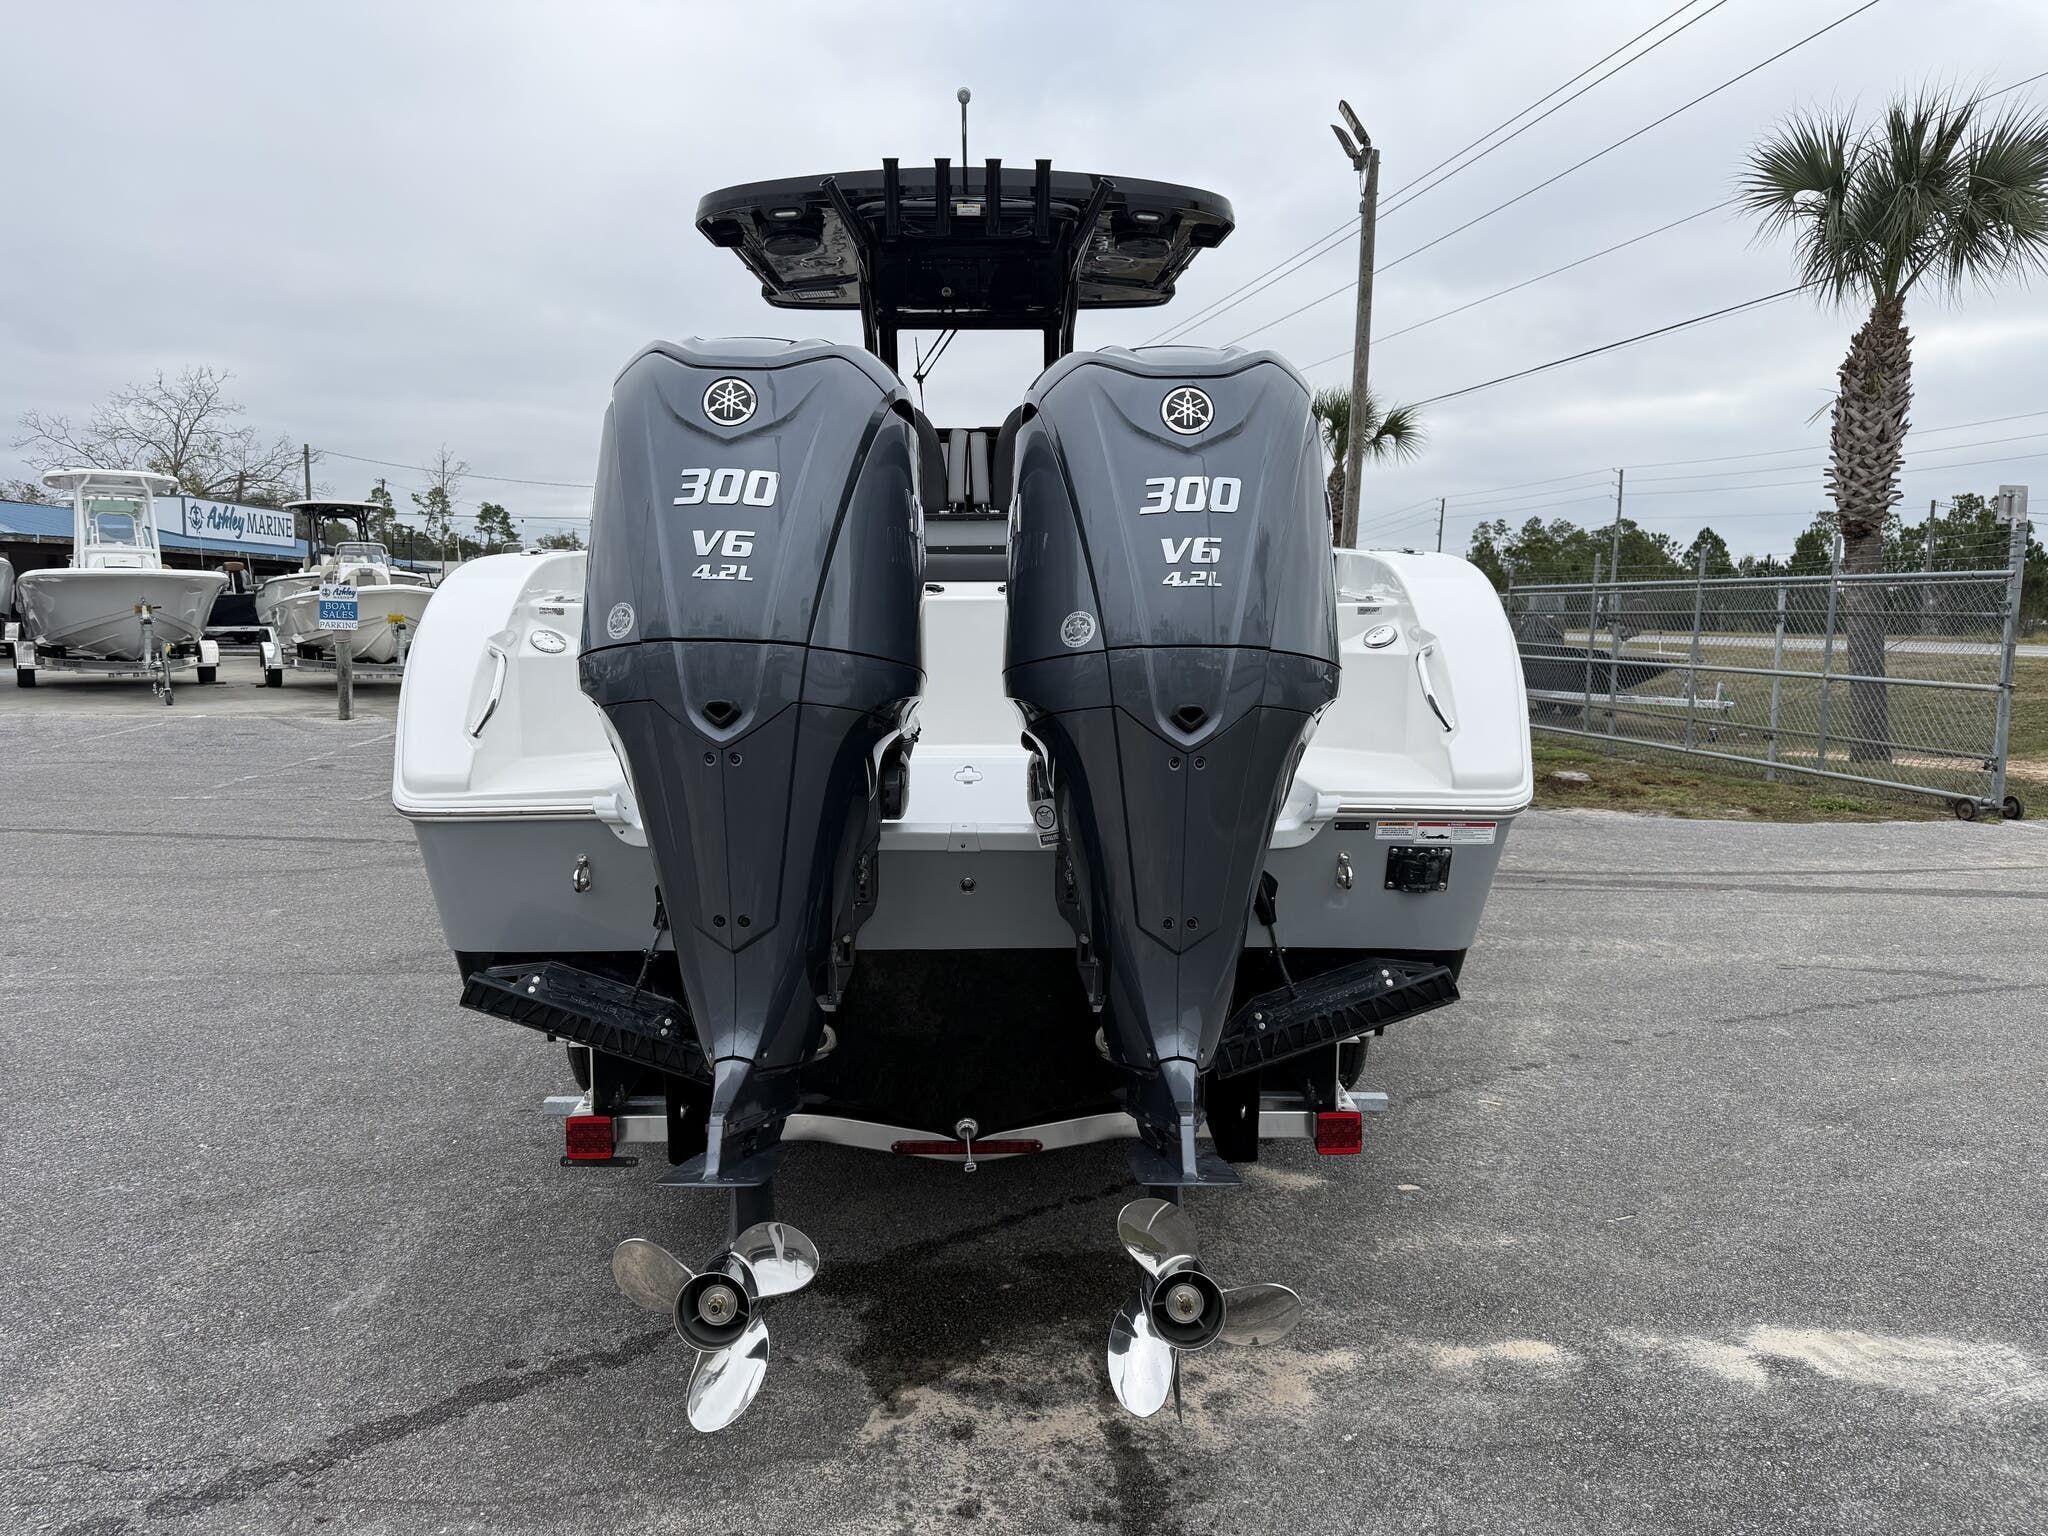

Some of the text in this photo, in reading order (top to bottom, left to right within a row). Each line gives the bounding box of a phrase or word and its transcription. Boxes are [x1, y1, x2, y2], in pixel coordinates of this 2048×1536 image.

[673, 468, 780, 507] 300
[1140, 476, 1242, 515] 300
[207, 505, 293, 540] Ashley MARINE
[692, 530, 756, 558] V6
[1160, 537, 1222, 564] V6
[692, 563, 754, 581] 4.2L
[1162, 571, 1223, 587] 4.2L
[332, 586, 357, 599] Ashley
[322, 610, 355, 619] SALES
[325, 602, 353, 611] BOAT
[319, 621, 358, 629] PARKING
